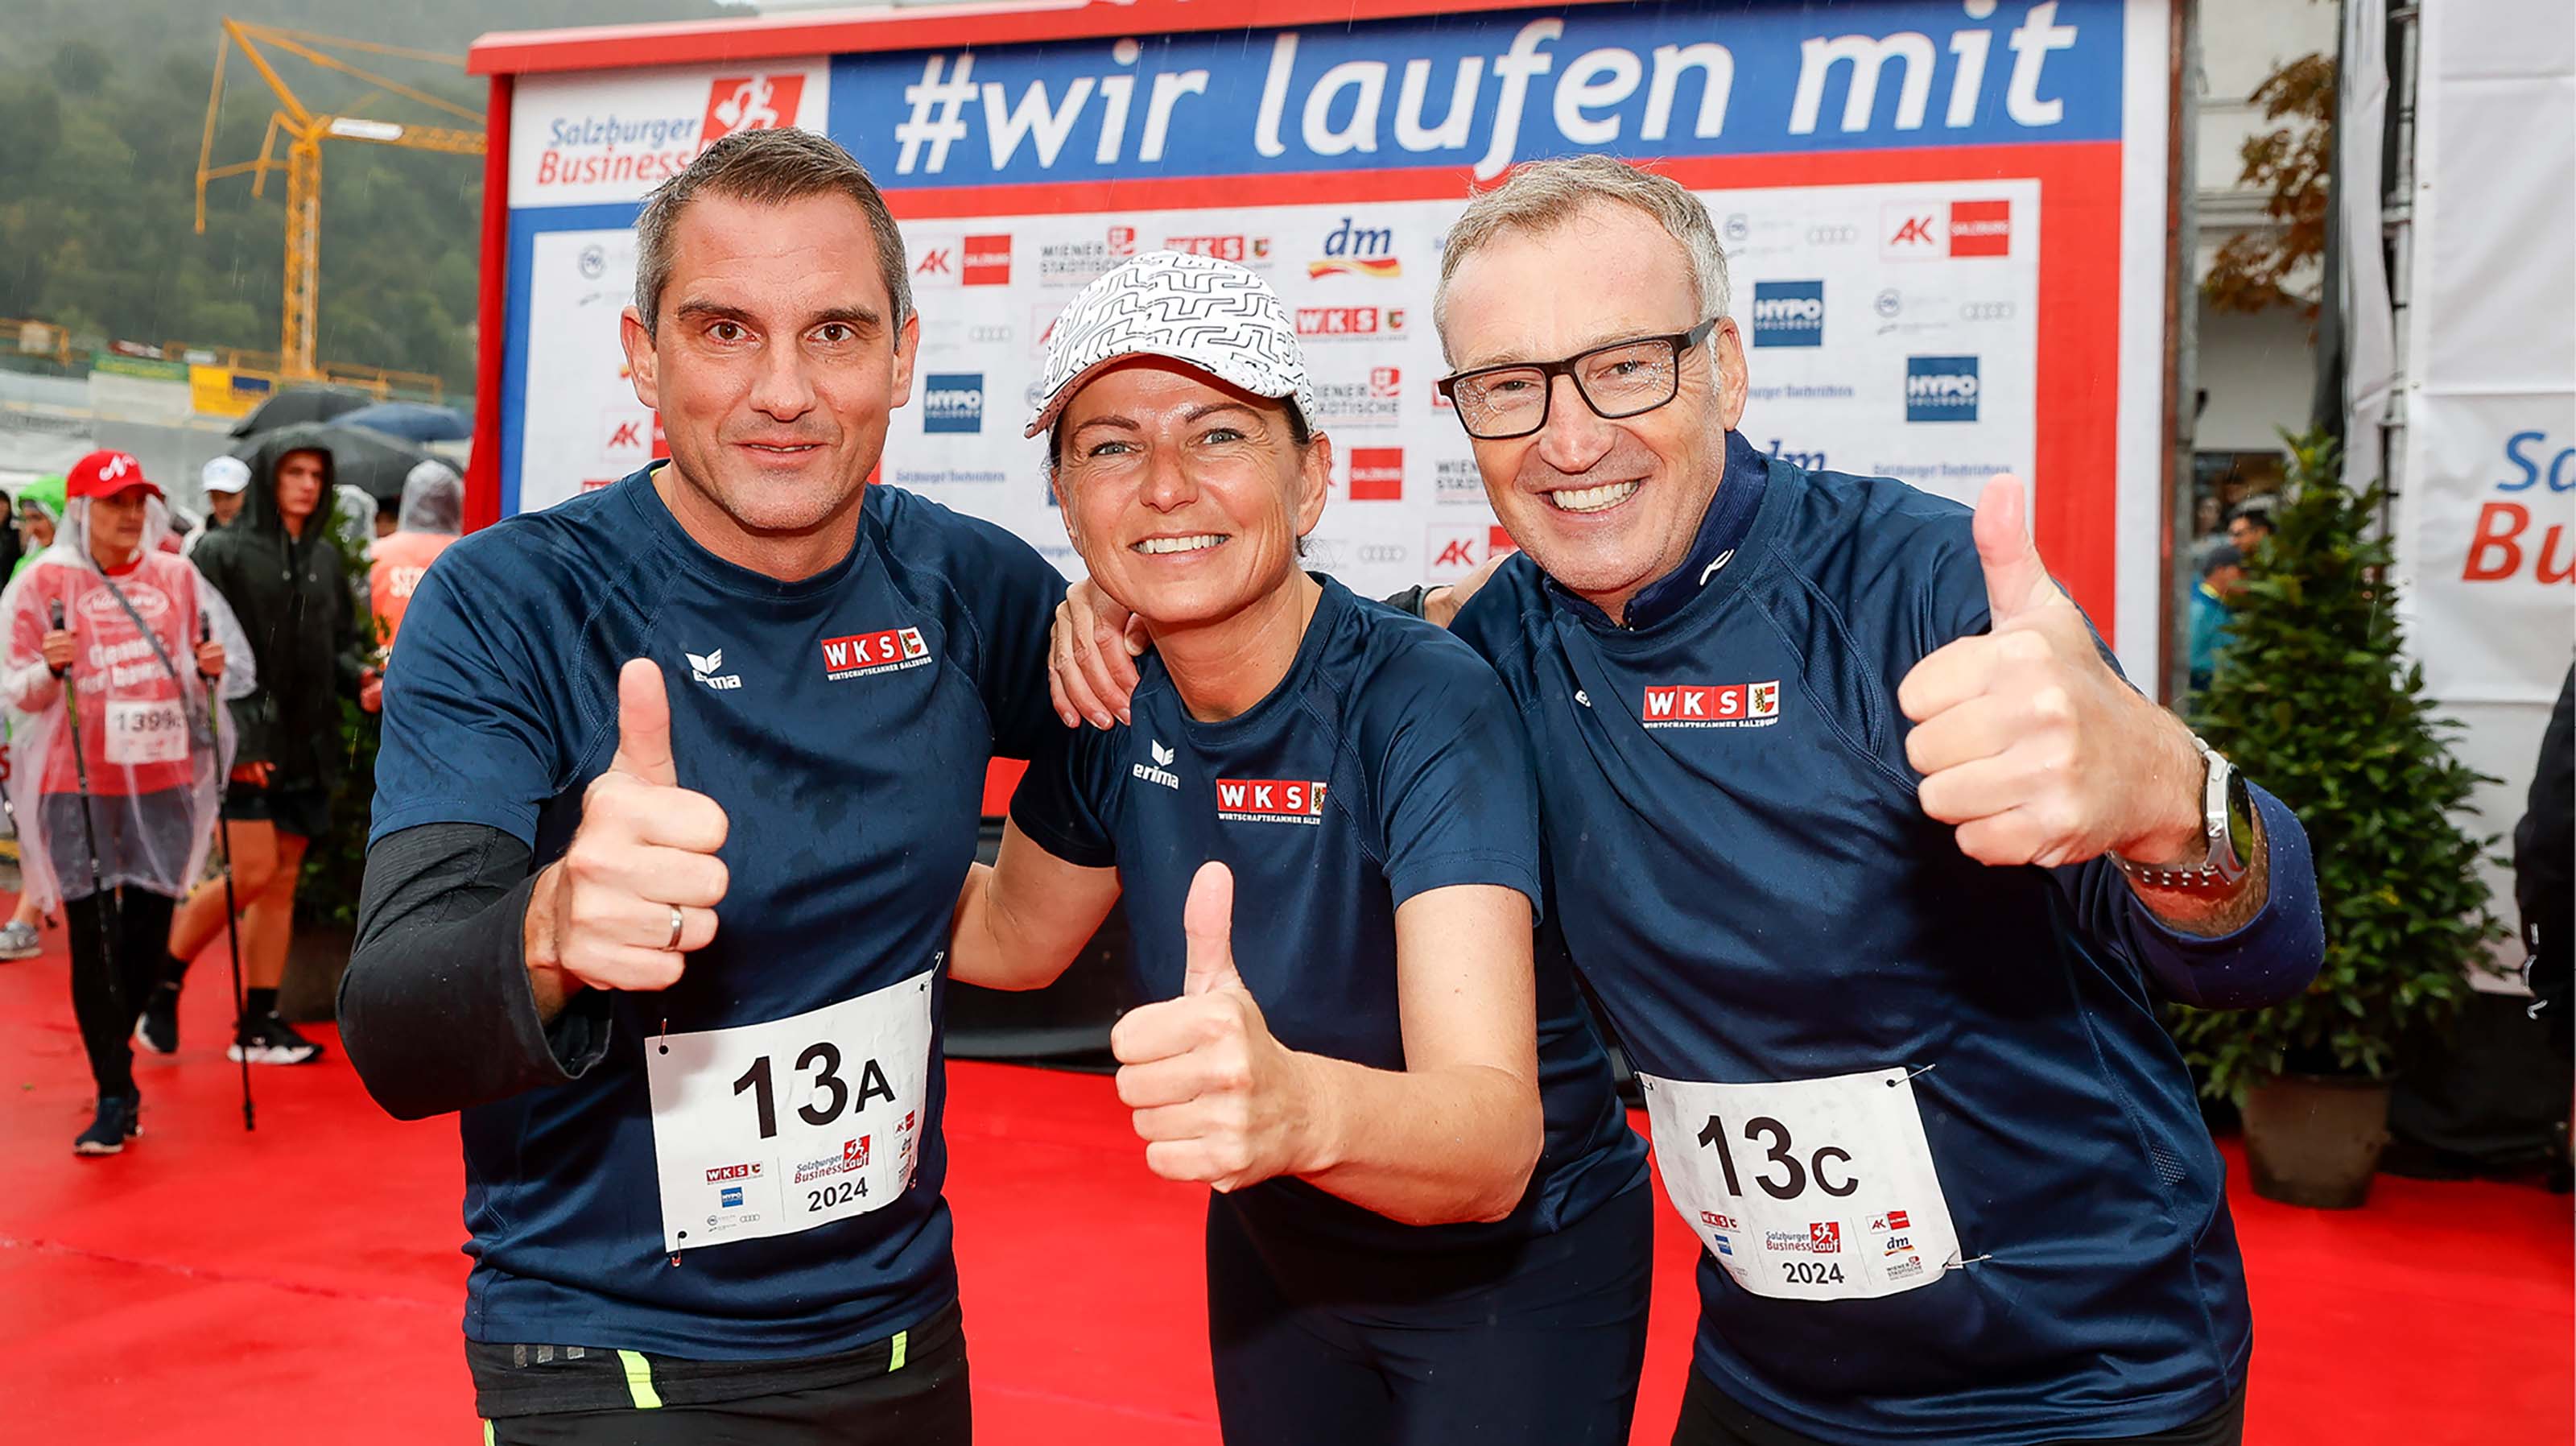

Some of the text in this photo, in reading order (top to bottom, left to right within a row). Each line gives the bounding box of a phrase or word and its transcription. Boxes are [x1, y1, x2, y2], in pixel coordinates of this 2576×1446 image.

[895, 0, 2078, 182] #wir laufen mit
[548, 114, 698, 148] Salzburger
[536, 145, 692, 186] Business
[1324, 217, 1392, 255] dm
[1891, 215, 1934, 245] AK
[916, 248, 950, 274] AK
[1298, 310, 1376, 333] WKS
[1756, 299, 1822, 320] HYPO
[1314, 385, 1368, 398] IENER
[1909, 374, 1977, 398] HYPO
[927, 390, 981, 410] HYPO
[609, 422, 640, 448] AK
[1435, 539, 1474, 567] AK
[2462, 501, 2576, 585] Bu
[824, 635, 895, 667] WKS
[828, 663, 899, 682] WIRTSCHAFTSKAMMER
[1647, 690, 1739, 716] WKS
[1642, 721, 1737, 729] WIRTSCHAFTSKAMMER
[1133, 762, 1179, 791] erima
[1219, 784, 1303, 810] WKS
[1218, 812, 1302, 824] WIRTSCHAFTSKAMMER
[733, 1042, 895, 1139] 13A
[797, 1155, 842, 1172] Salzburger
[1698, 1115, 1859, 1200] 13C
[708, 1166, 746, 1181] WKS
[795, 1163, 843, 1184] Business
[807, 1176, 869, 1212] 2024
[1765, 1230, 1810, 1242] Salzburger
[1872, 1218, 1886, 1229] AK
[1765, 1238, 1839, 1252] Business Lauf
[1887, 1236, 1909, 1250] dm
[1782, 1262, 1844, 1284] 2024
